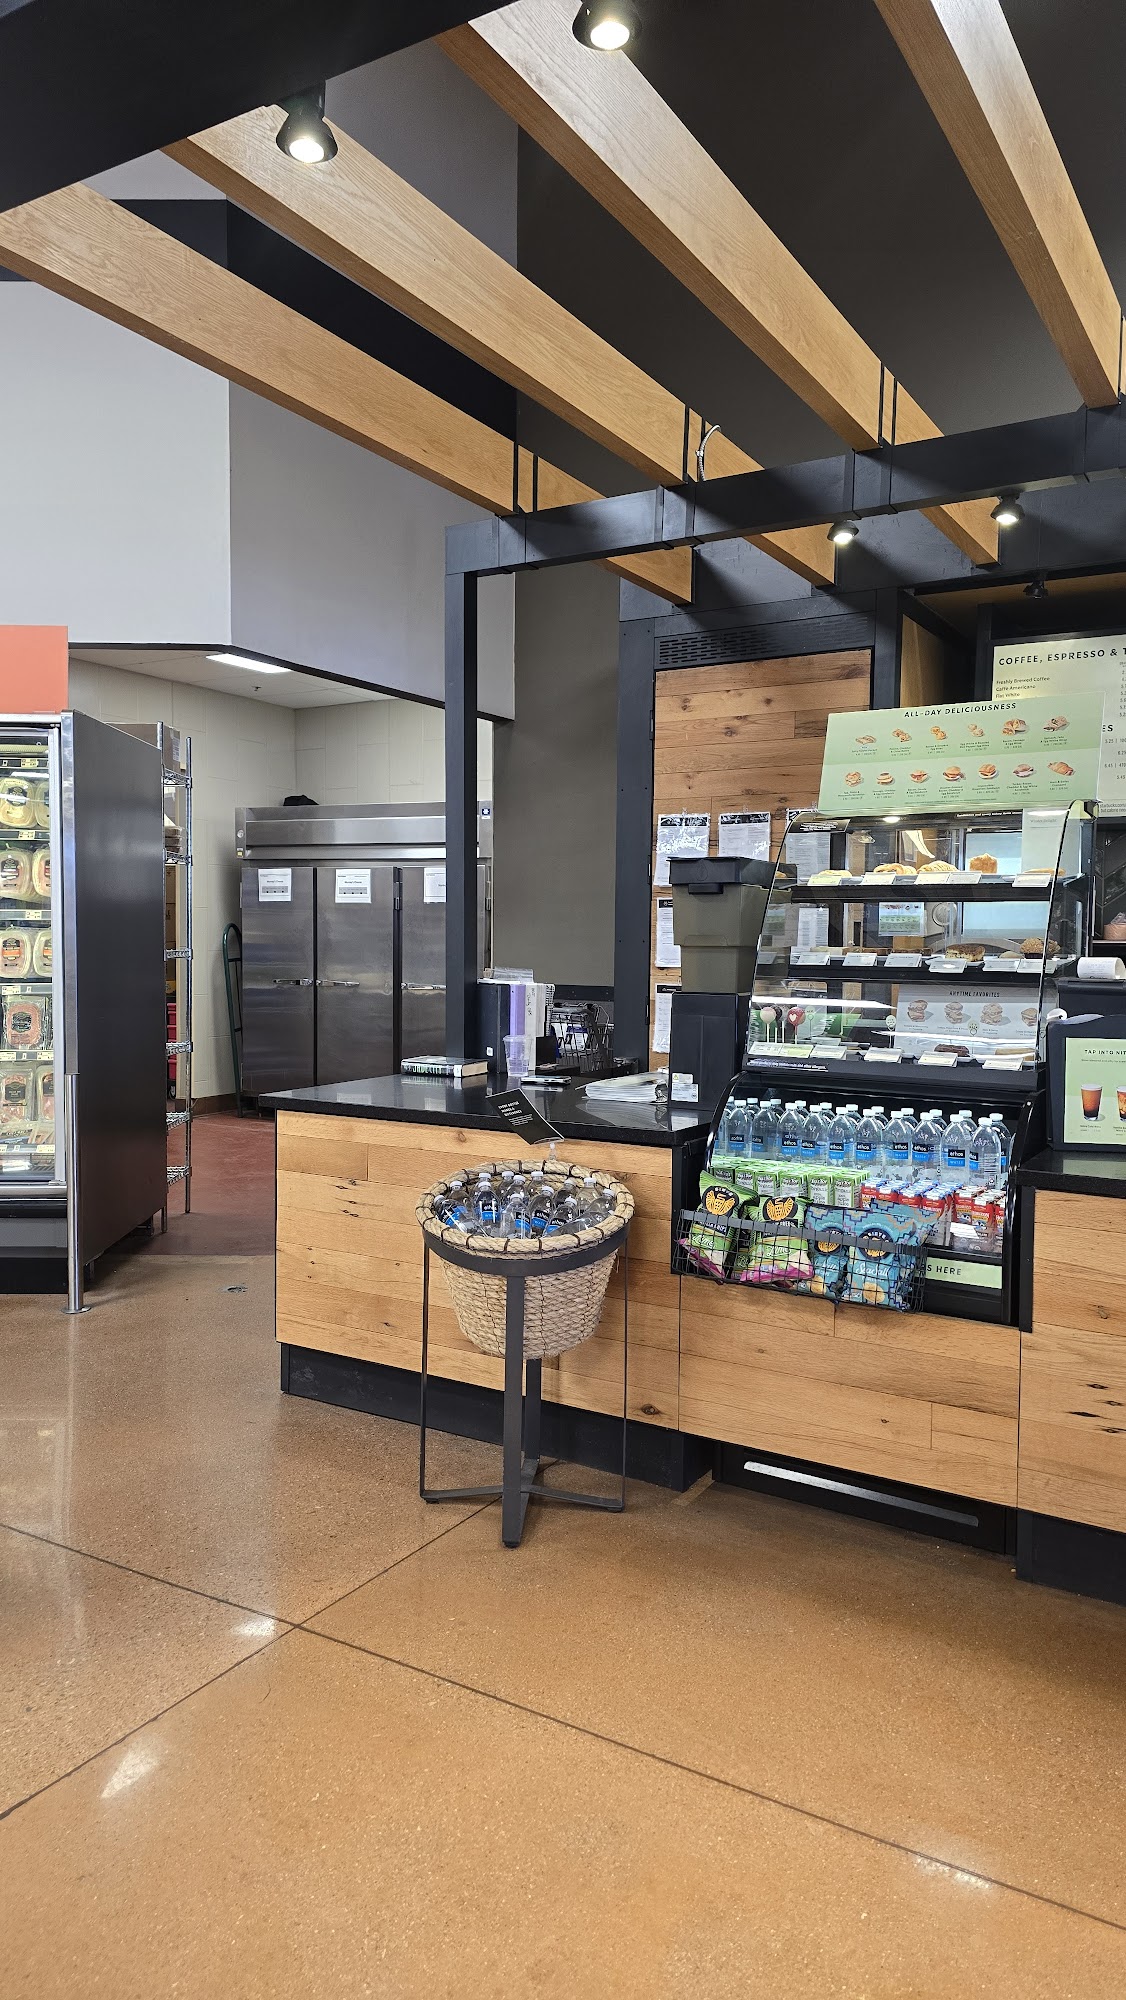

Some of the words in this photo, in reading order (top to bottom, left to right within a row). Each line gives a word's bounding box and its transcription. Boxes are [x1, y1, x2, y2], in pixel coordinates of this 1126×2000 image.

[998, 654, 1043, 666] COFFEE,
[1047, 649, 1105, 662] ESPRESSO
[1109, 648, 1118, 657] &
[903, 708, 942, 718] ALL-DAY
[944, 702, 1017, 715] DELICIOUSNESS
[936, 1264, 962, 1276] HERE
